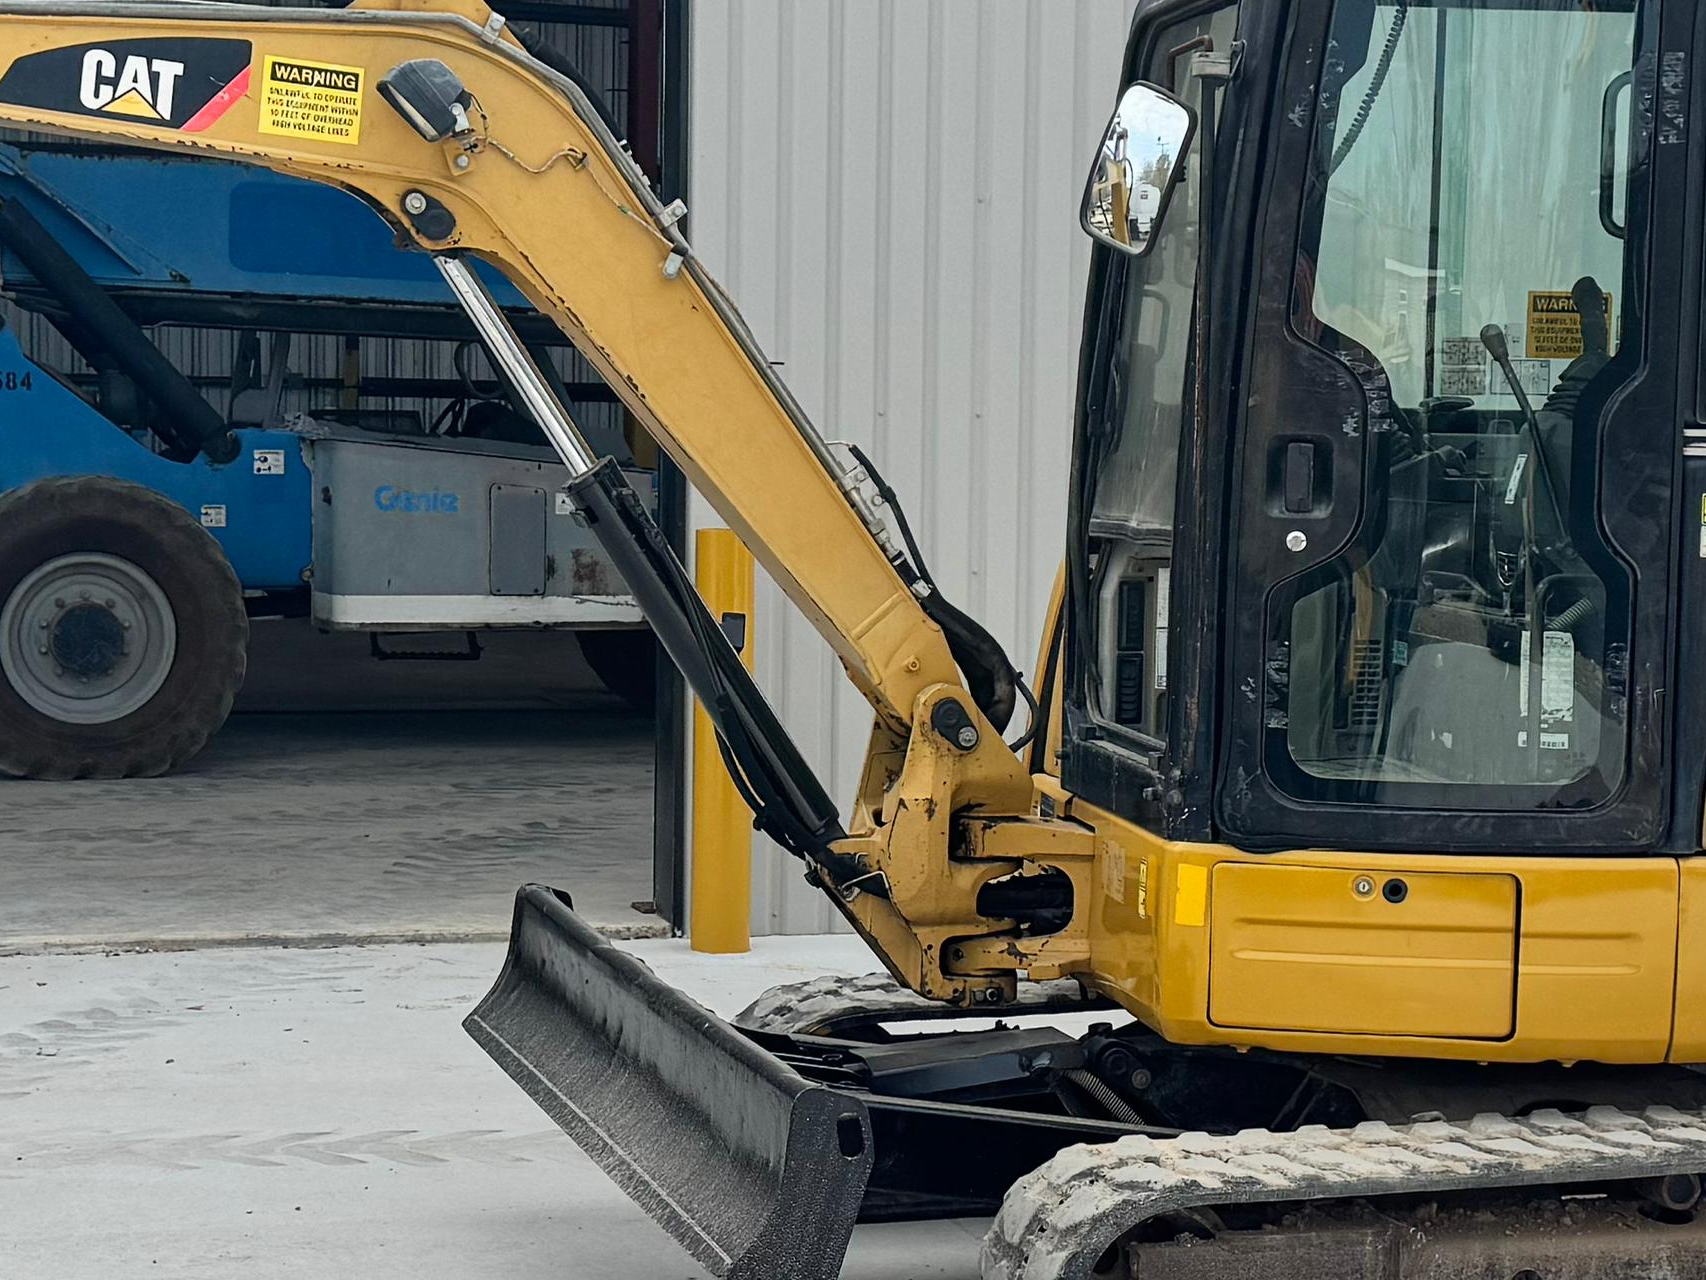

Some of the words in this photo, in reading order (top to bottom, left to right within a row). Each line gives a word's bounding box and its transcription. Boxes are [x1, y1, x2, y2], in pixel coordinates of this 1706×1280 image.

[79, 48, 185, 121] CAT
[274, 64, 357, 89] WARNING
[1535, 297, 1606, 311] WARN
[373, 484, 461, 513] Genie
